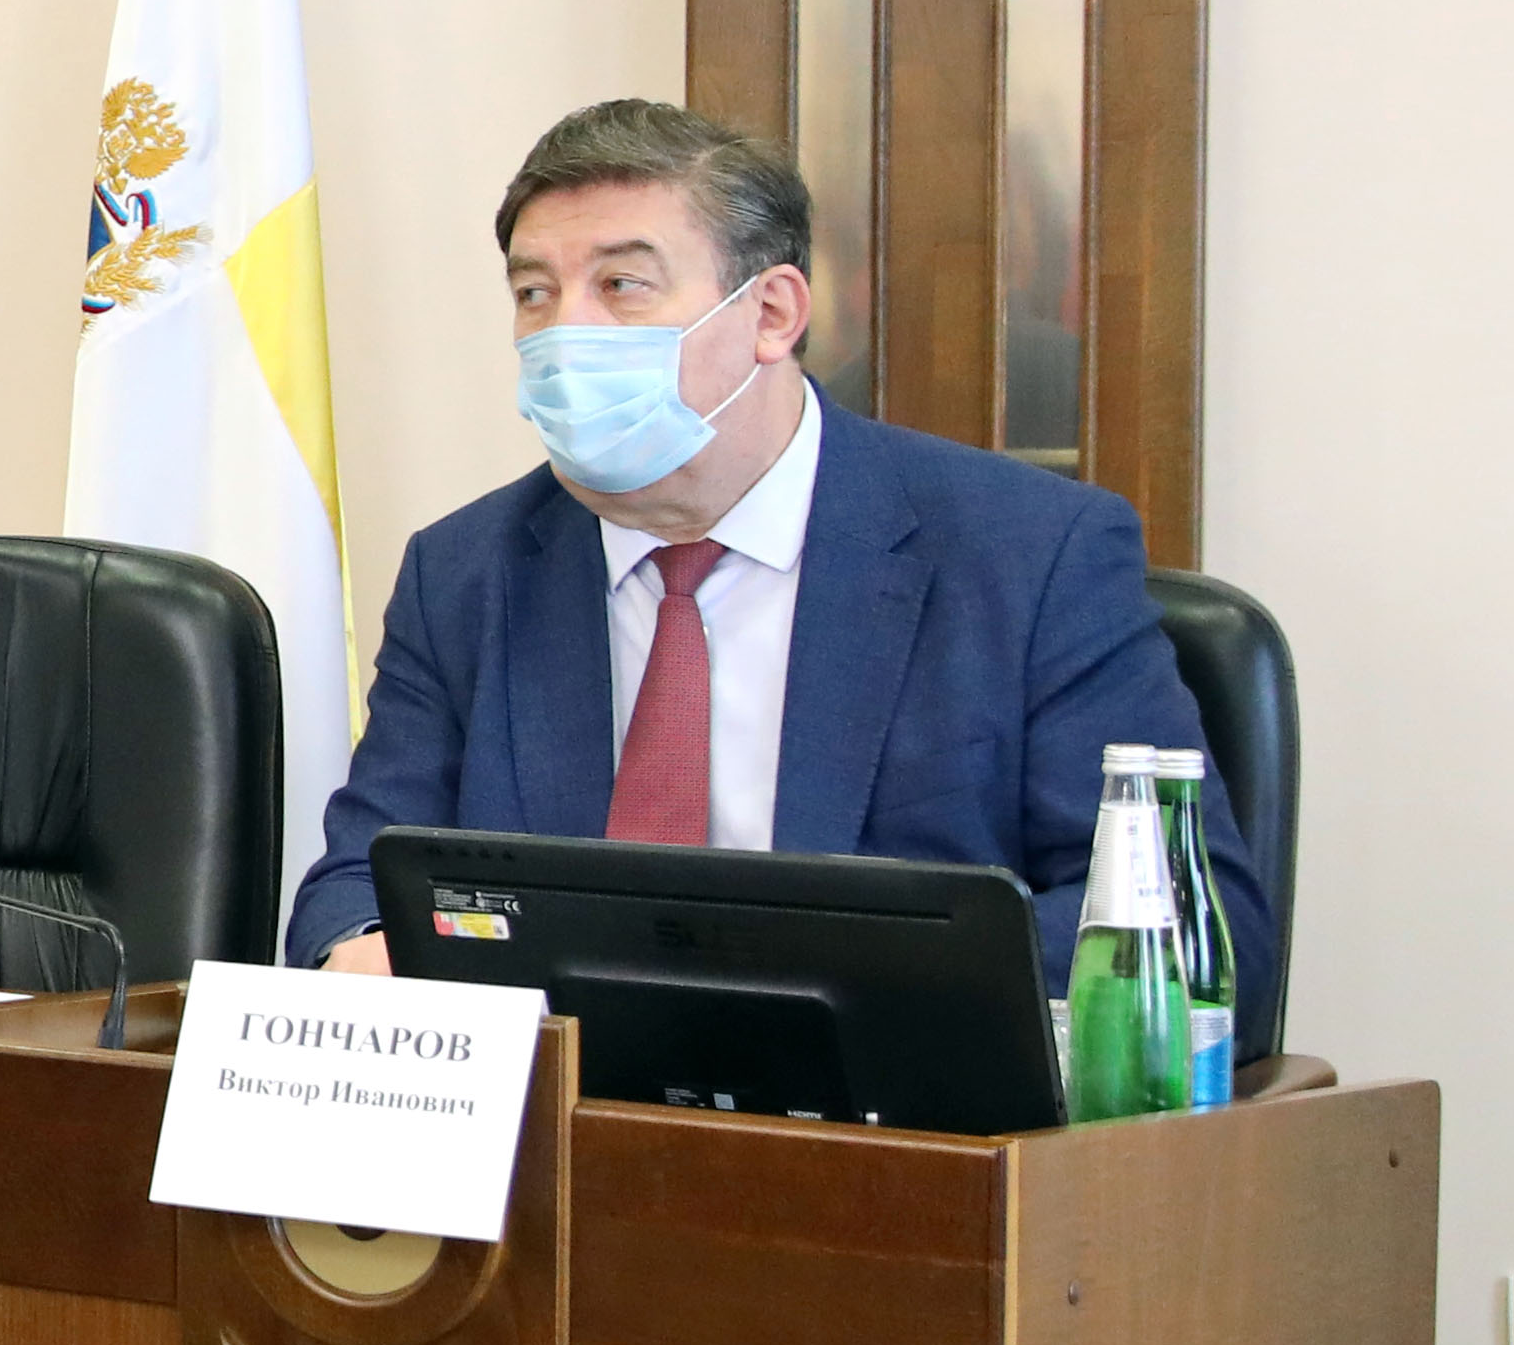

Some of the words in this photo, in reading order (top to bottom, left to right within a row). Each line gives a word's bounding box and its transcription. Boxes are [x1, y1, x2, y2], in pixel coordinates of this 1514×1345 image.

[239, 1012, 473, 1063] ГОНЧАРОВ
[217, 1067, 322, 1107] Виктор
[330, 1079, 475, 1117] Иванович
